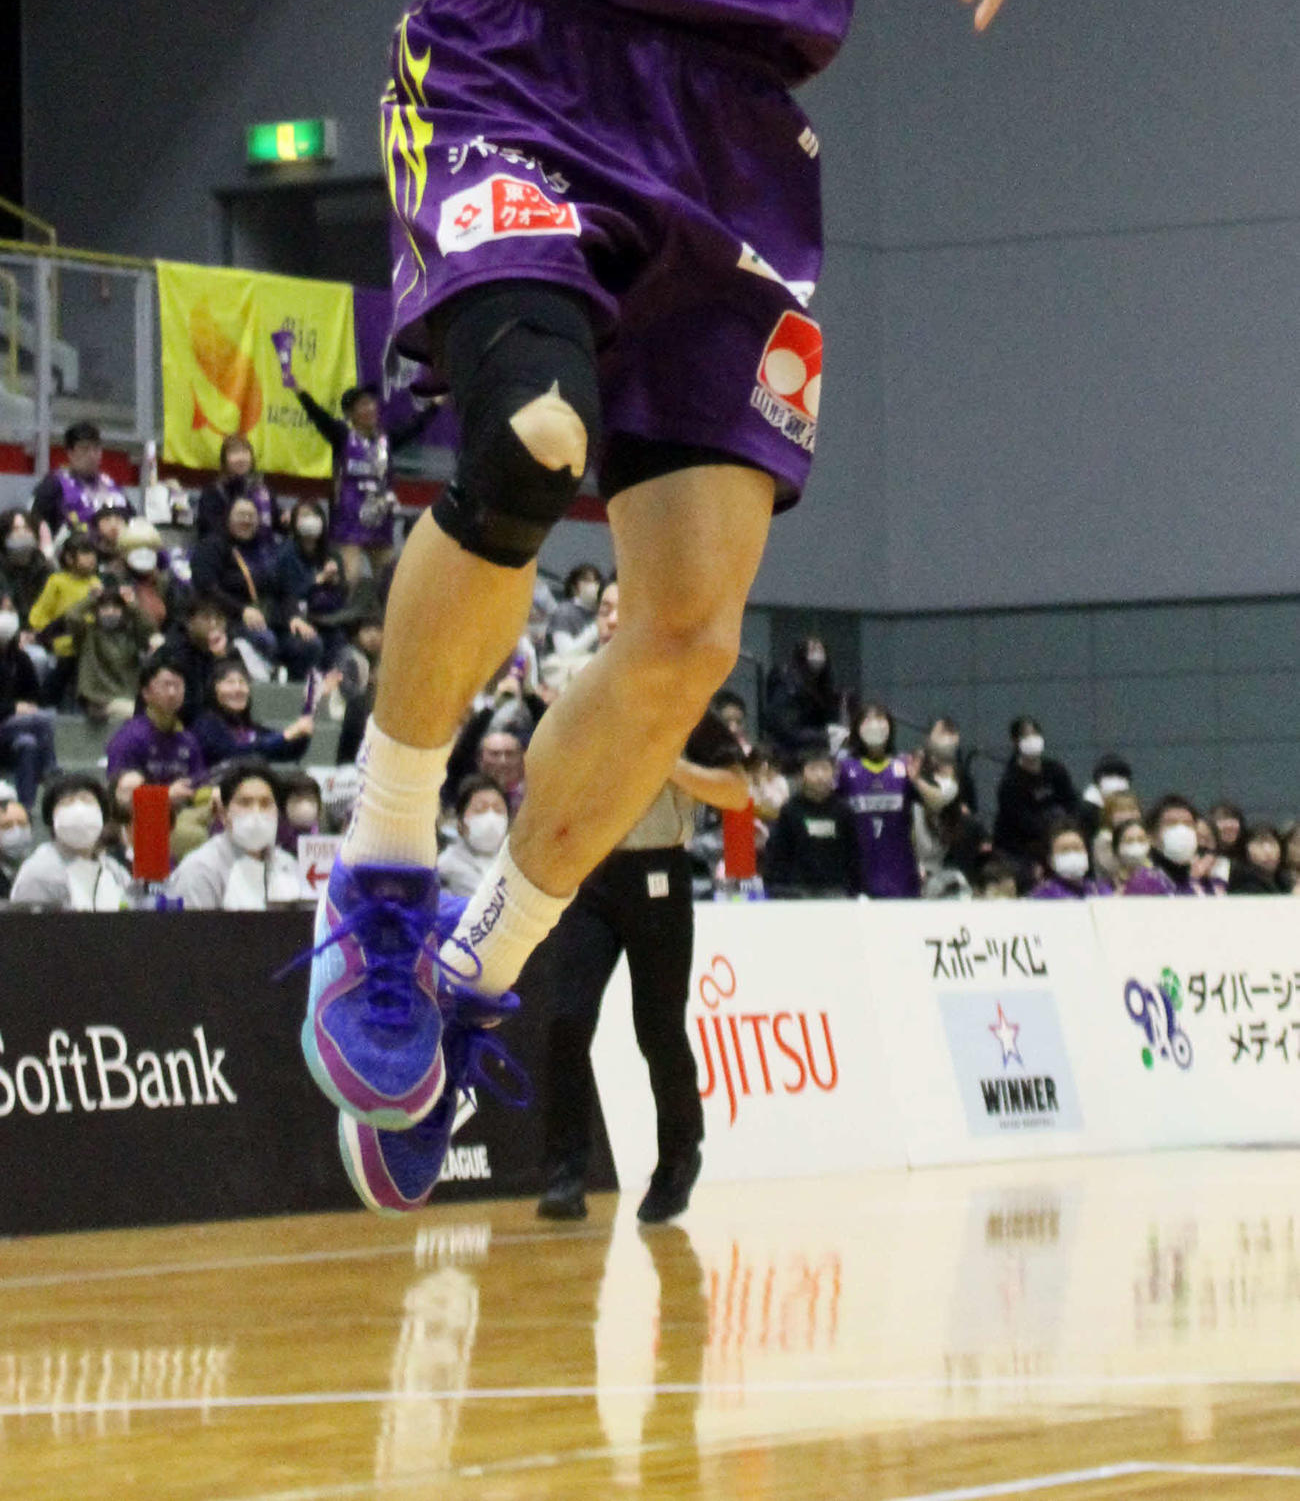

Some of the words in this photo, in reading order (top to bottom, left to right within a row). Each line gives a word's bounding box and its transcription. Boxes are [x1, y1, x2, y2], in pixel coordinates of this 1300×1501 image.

[872, 818, 884, 840] 7
[924, 924, 1048, 979] スポーツくじ
[980, 1076, 1059, 1116] WINNER
